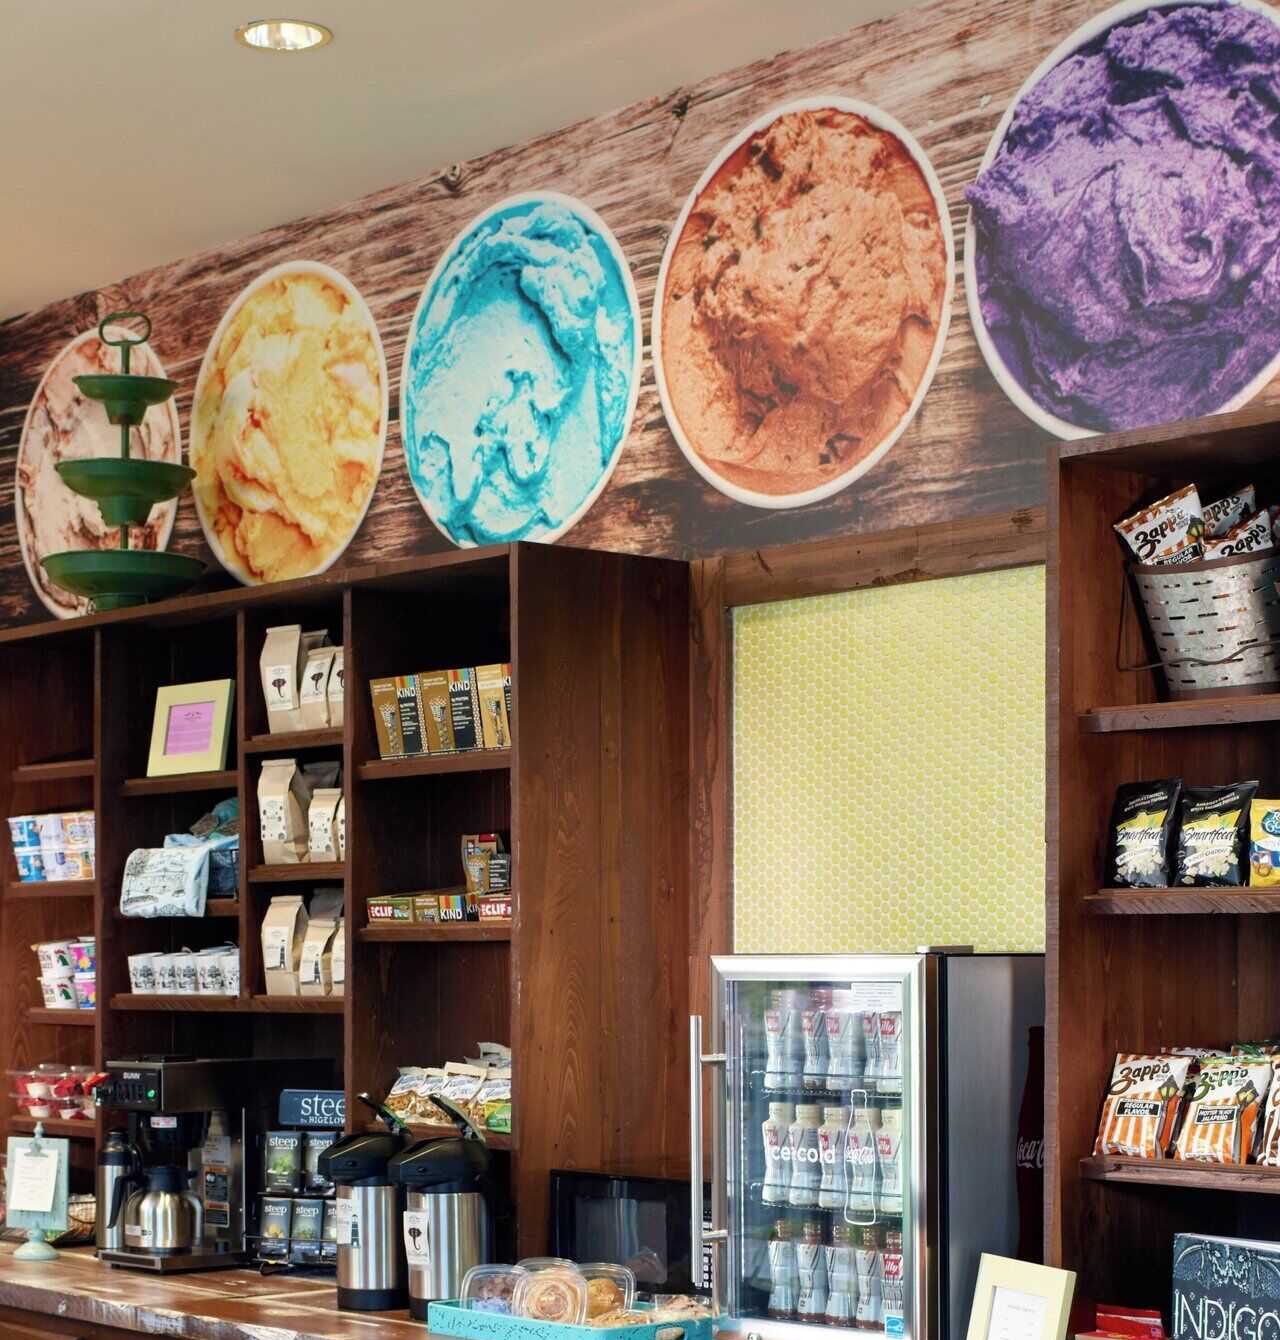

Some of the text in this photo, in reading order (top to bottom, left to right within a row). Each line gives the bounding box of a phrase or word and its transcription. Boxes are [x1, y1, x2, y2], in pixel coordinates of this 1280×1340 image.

[449, 681, 470, 692] KIND
[397, 688, 416, 698] KIND
[374, 906, 393, 917] CLIF
[440, 909, 462, 919] KIND
[467, 904, 478, 913] KIN
[485, 904, 506, 916] CLIF
[881, 1020, 894, 1033] illy
[123, 1072, 141, 1080] BUNN
[301, 1094, 345, 1116] stee
[269, 1136, 298, 1149] steep
[310, 1138, 333, 1149] steep
[264, 1205, 287, 1216] steep
[296, 1206, 319, 1218] steep
[885, 1260, 898, 1274] illy
